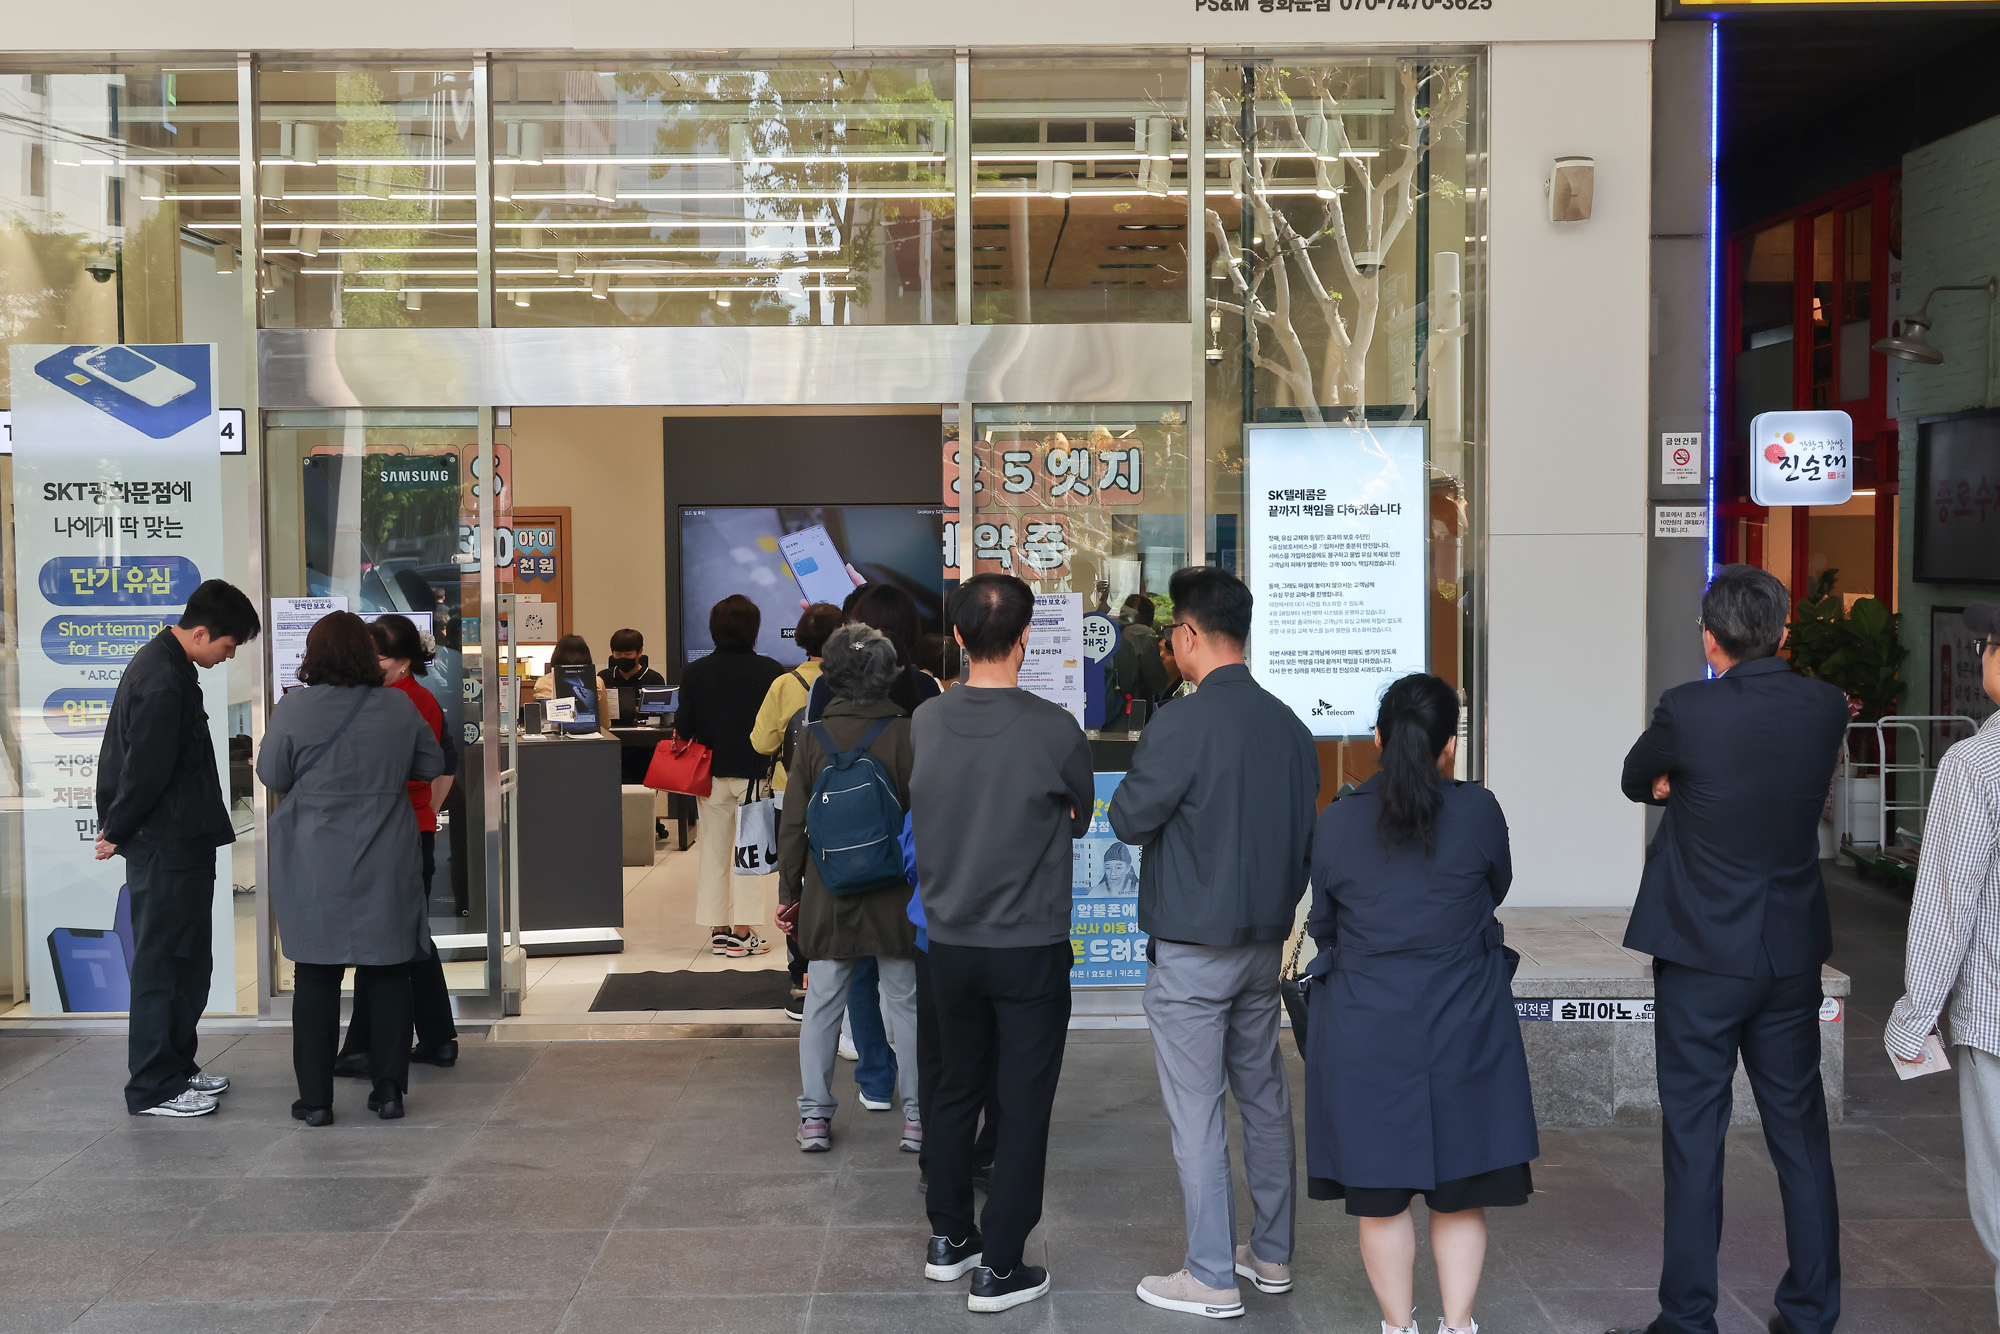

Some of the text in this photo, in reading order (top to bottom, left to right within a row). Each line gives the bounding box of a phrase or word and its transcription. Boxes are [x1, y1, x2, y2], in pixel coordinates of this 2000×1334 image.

[1666, 437, 1697, 445] 금연건물
[1778, 454, 1846, 481] 진순대
[380, 470, 449, 483] SAMSUNG
[44, 482, 192, 505] SKT광화문점에
[1268, 489, 1326, 501] SK텔레콤은
[1268, 503, 1402, 517] 끝까지 책임을 다하겠습니다
[54, 516, 184, 538] 나에게 딱 맞는
[513, 530, 554, 548] 아이
[513, 558, 555, 574] 천원
[70, 566, 170, 594] 단기 유심
[58, 622, 104, 636] Short
[106, 622, 145, 636] term
[68, 641, 92, 656] for
[1311, 708, 1323, 716] SK
[53, 786, 97, 810] 저렴
[75, 819, 100, 841] 만
[734, 844, 759, 868] KE
[1077, 904, 1136, 918] 알뜰폰에
[1089, 938, 1147, 962] 드려요
[1119, 969, 1141, 977] 키즈폰
[1561, 1002, 1632, 1020] 숨피아노
